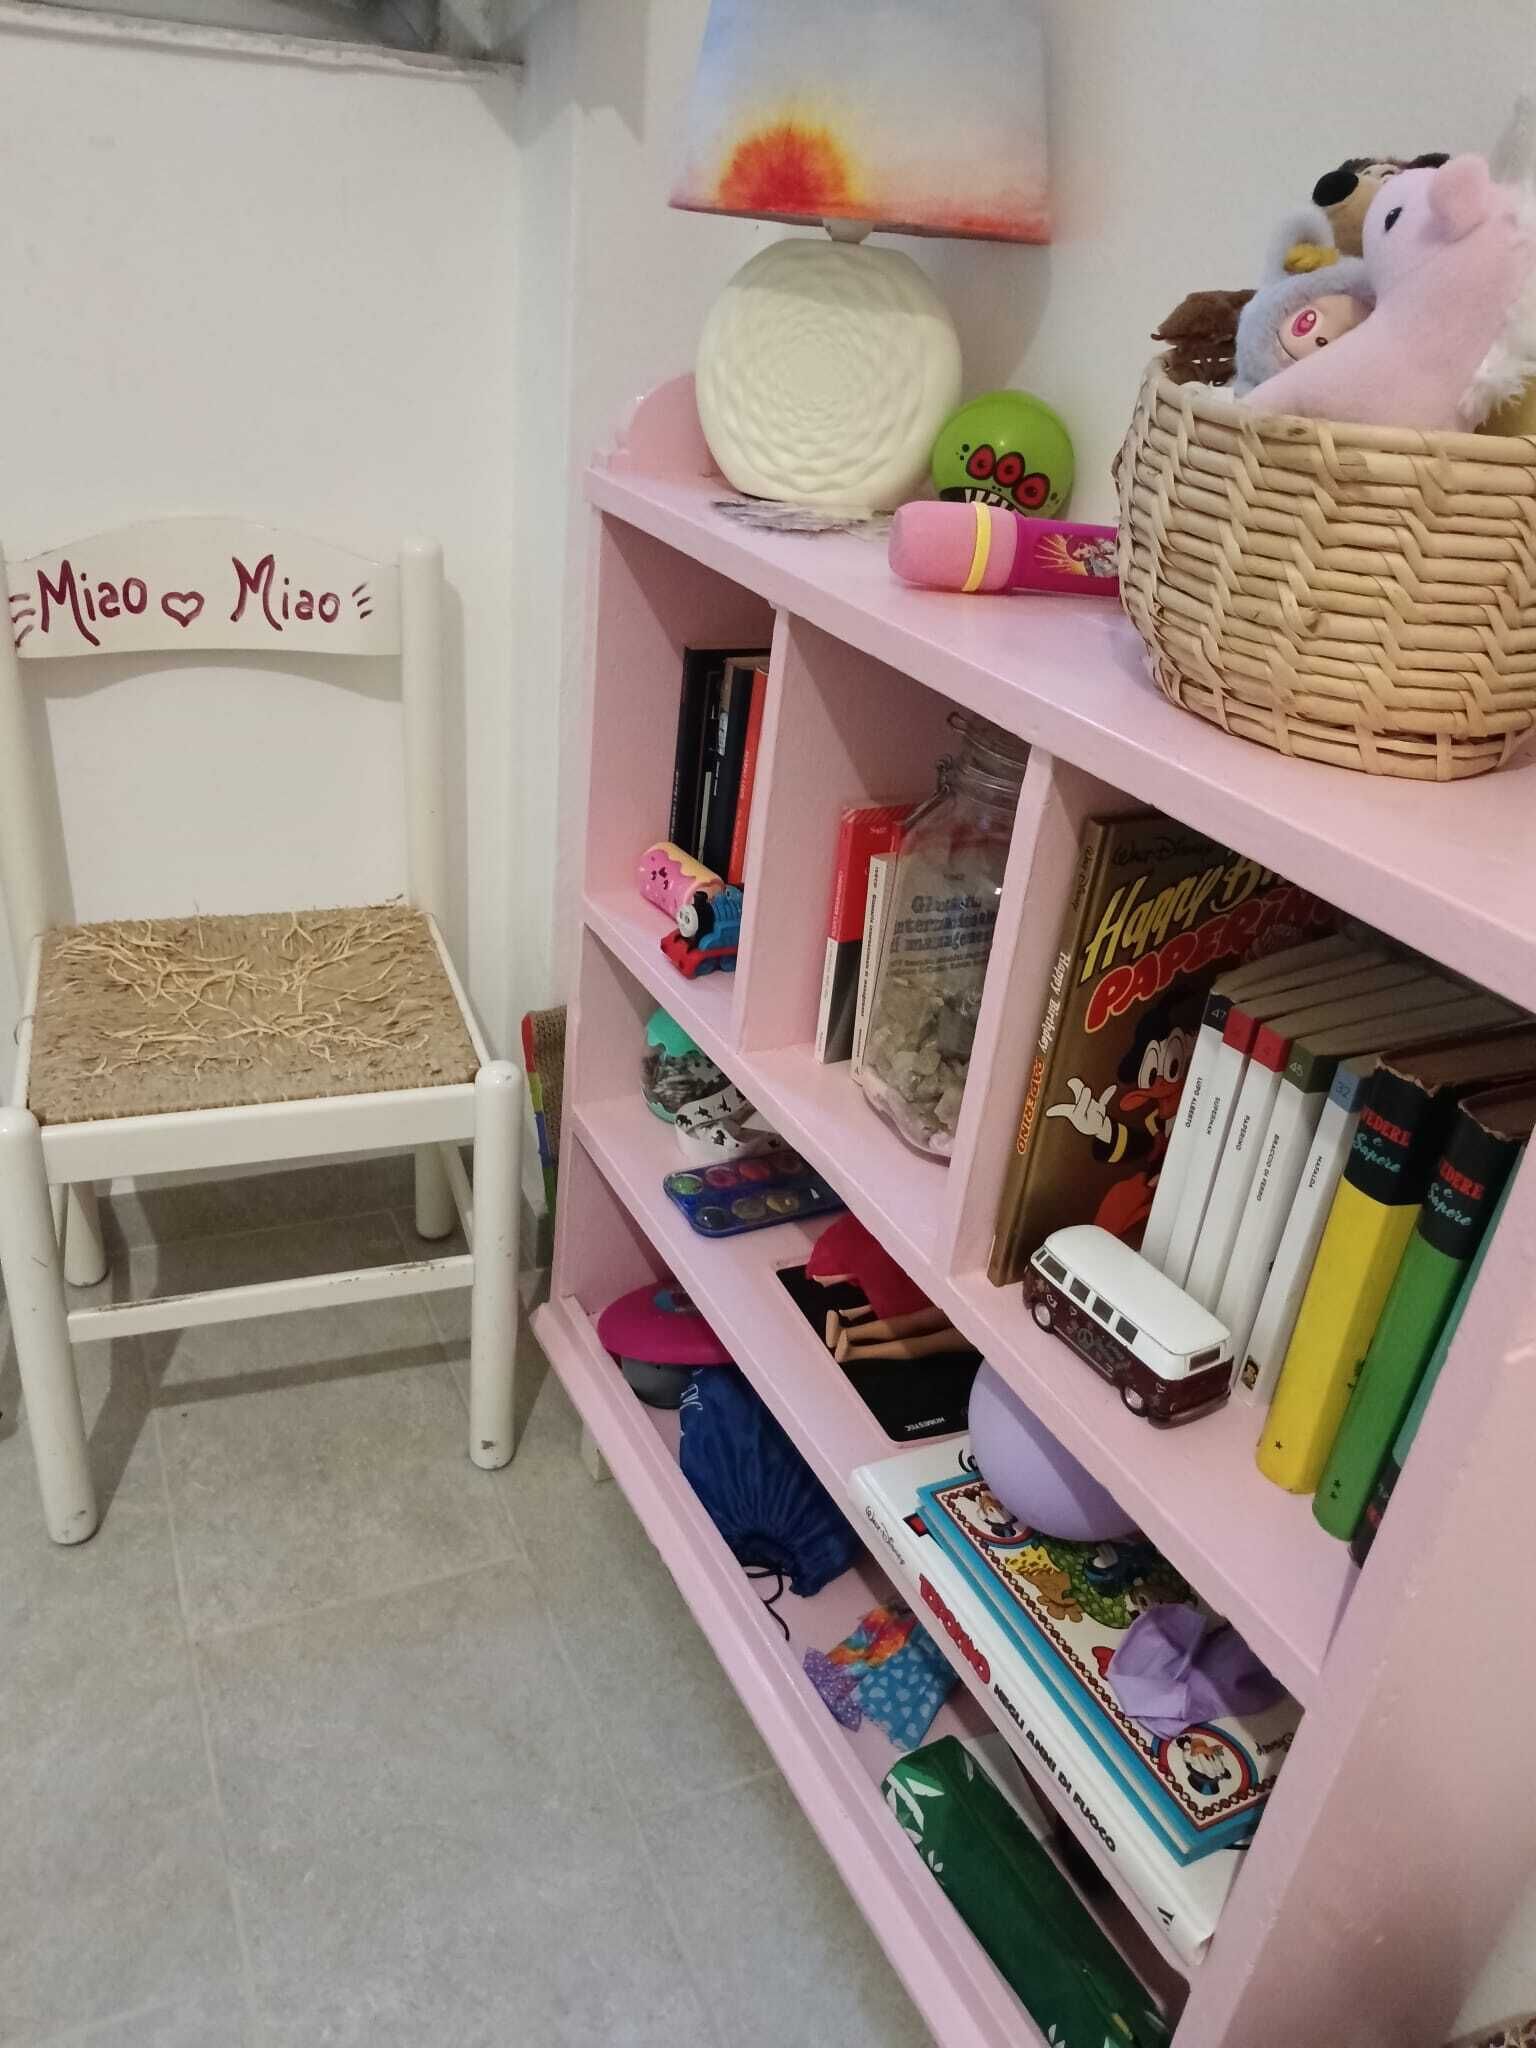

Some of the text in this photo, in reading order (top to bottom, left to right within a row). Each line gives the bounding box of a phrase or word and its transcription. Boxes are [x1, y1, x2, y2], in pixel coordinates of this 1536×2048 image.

[37, 554, 341, 646] Miao Miao
[1081, 864, 1225, 983] Happy
[1016, 952, 1072, 1156] Happy Birthday PAPERINO
[1353, 1132, 1401, 1173] Sapere
[994, 1683, 1025, 1730] NEGLI
[1026, 1730, 1057, 1773] ANNI
[1058, 1771, 1072, 1794] DI
[1073, 1792, 1116, 1853] FUOCO
